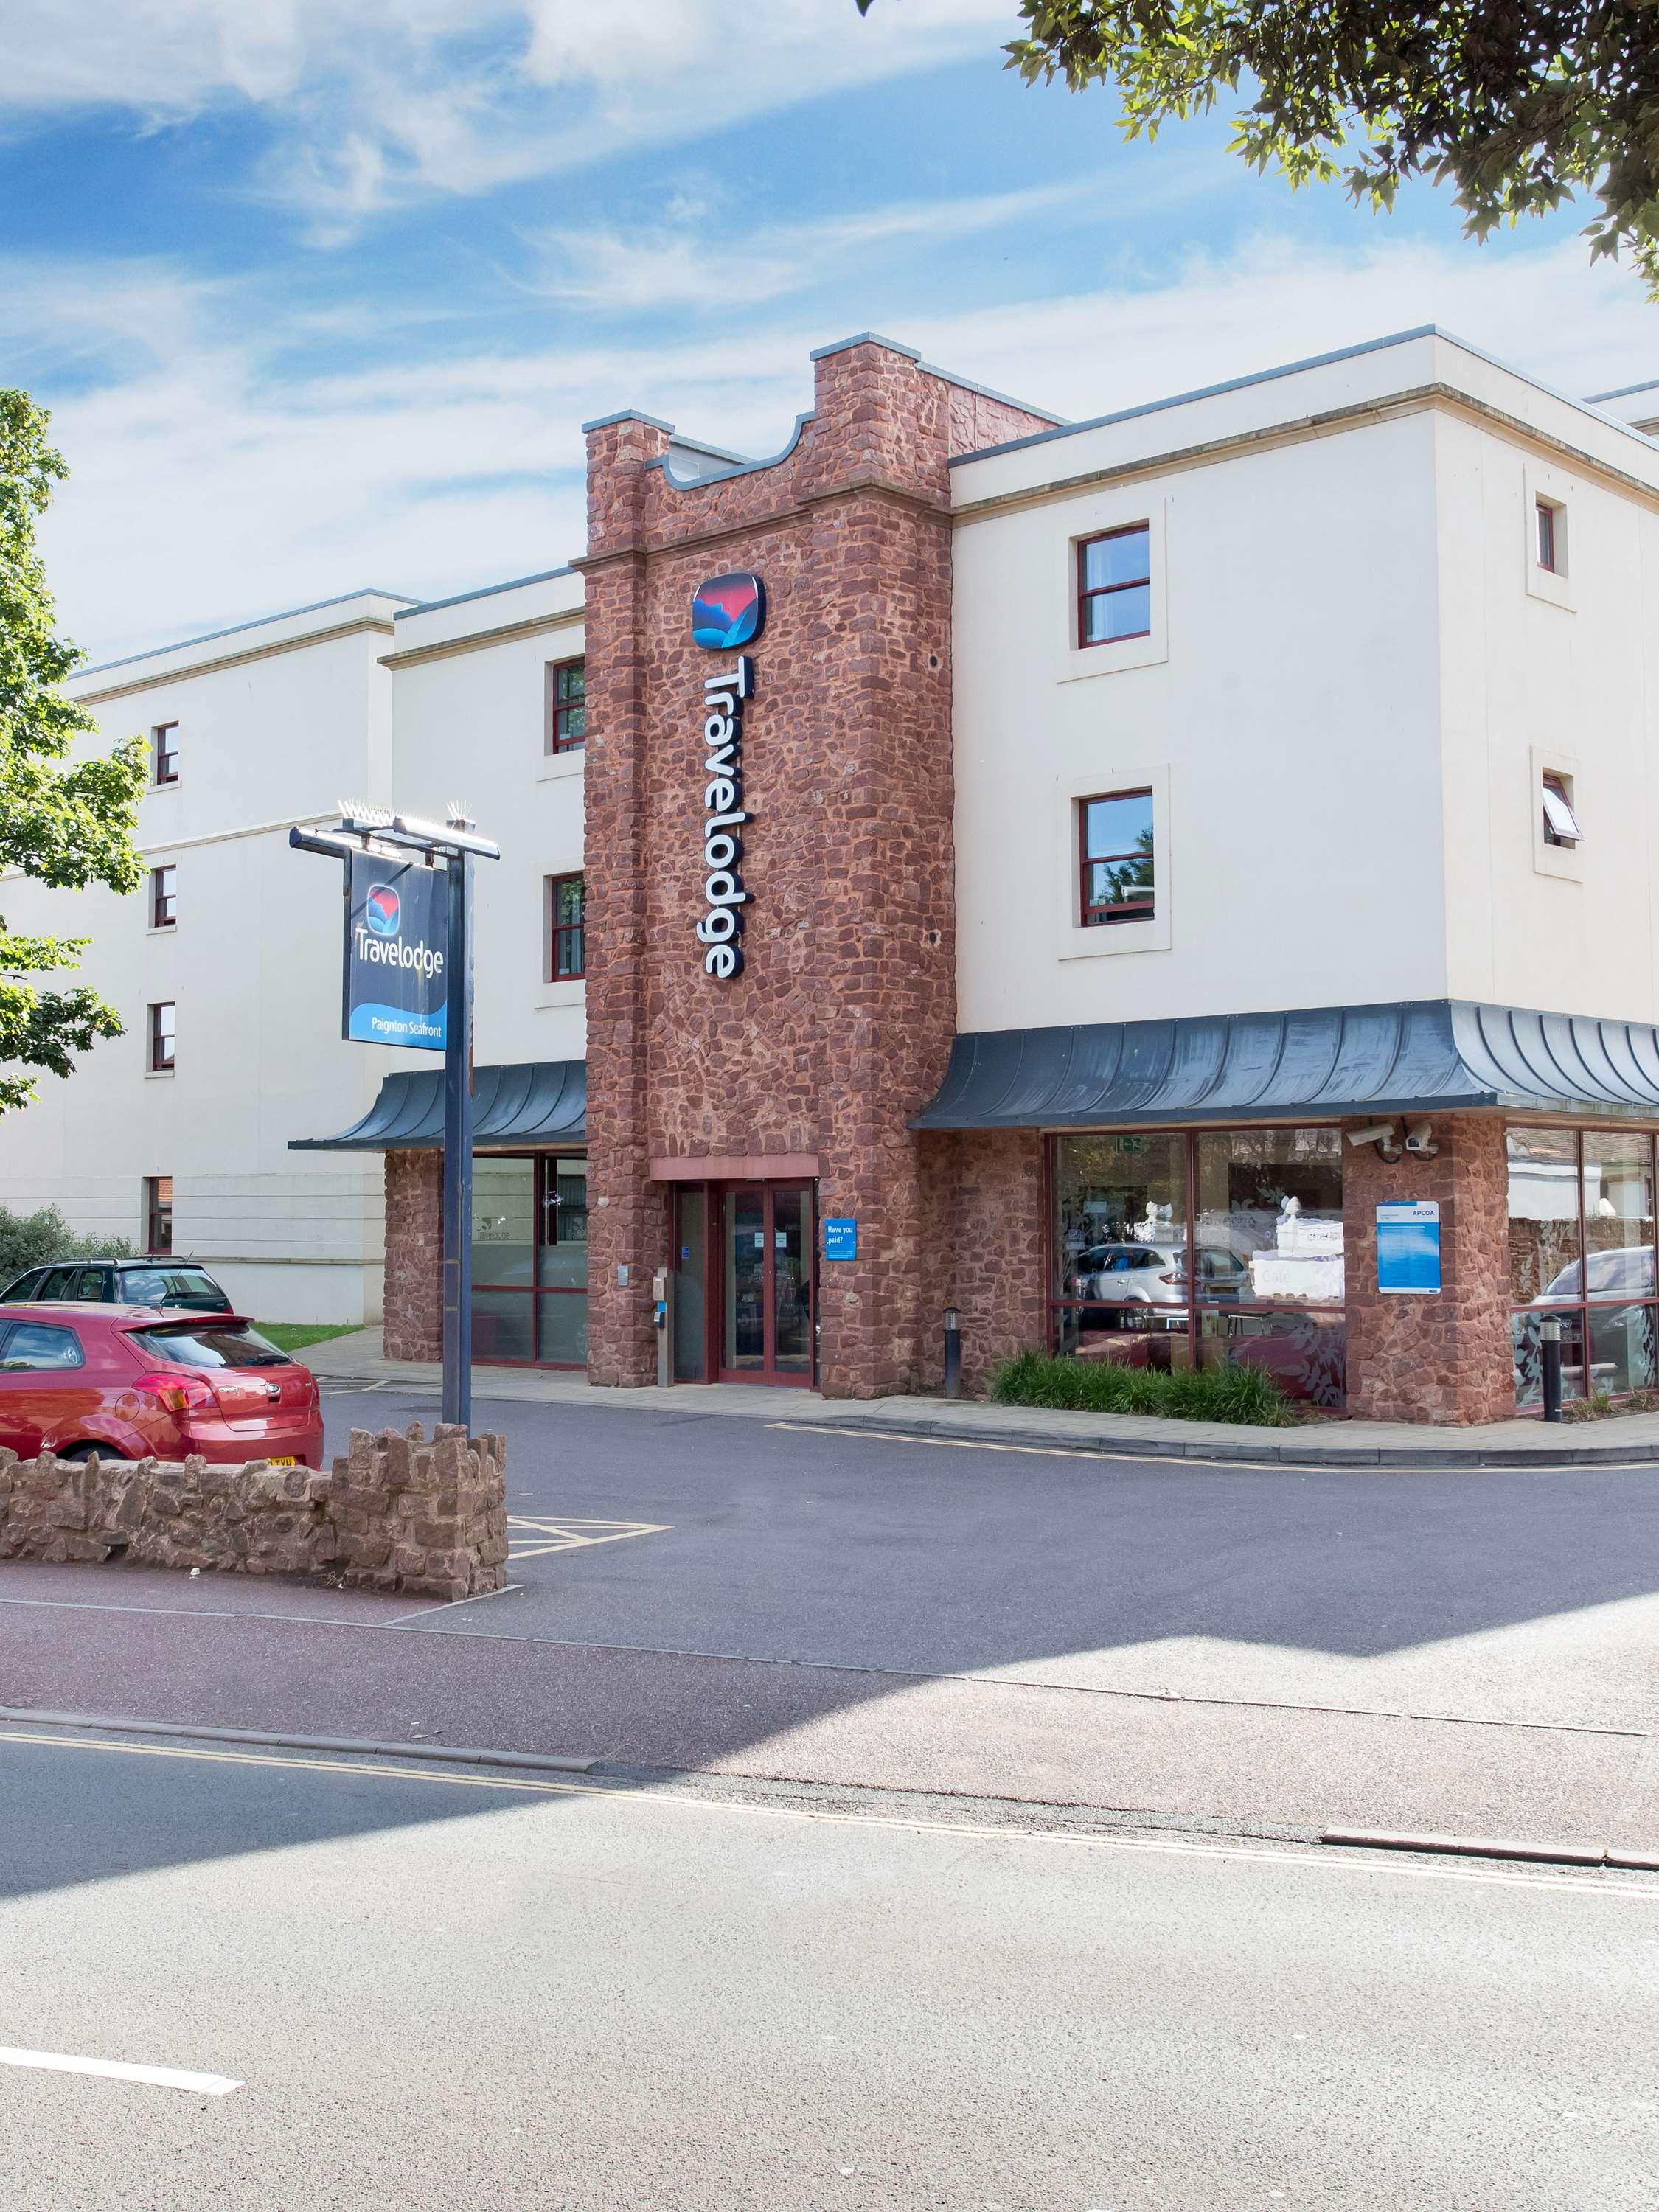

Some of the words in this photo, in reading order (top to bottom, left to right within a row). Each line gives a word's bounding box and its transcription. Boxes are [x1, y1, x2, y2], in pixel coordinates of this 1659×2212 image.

[696, 655, 748, 978] Travelodge
[356, 928, 444, 979] Travelodge
[372, 1017, 408, 1034] Paignton
[408, 1021, 442, 1037] Seafront
[828, 1236, 844, 1245] paid?
